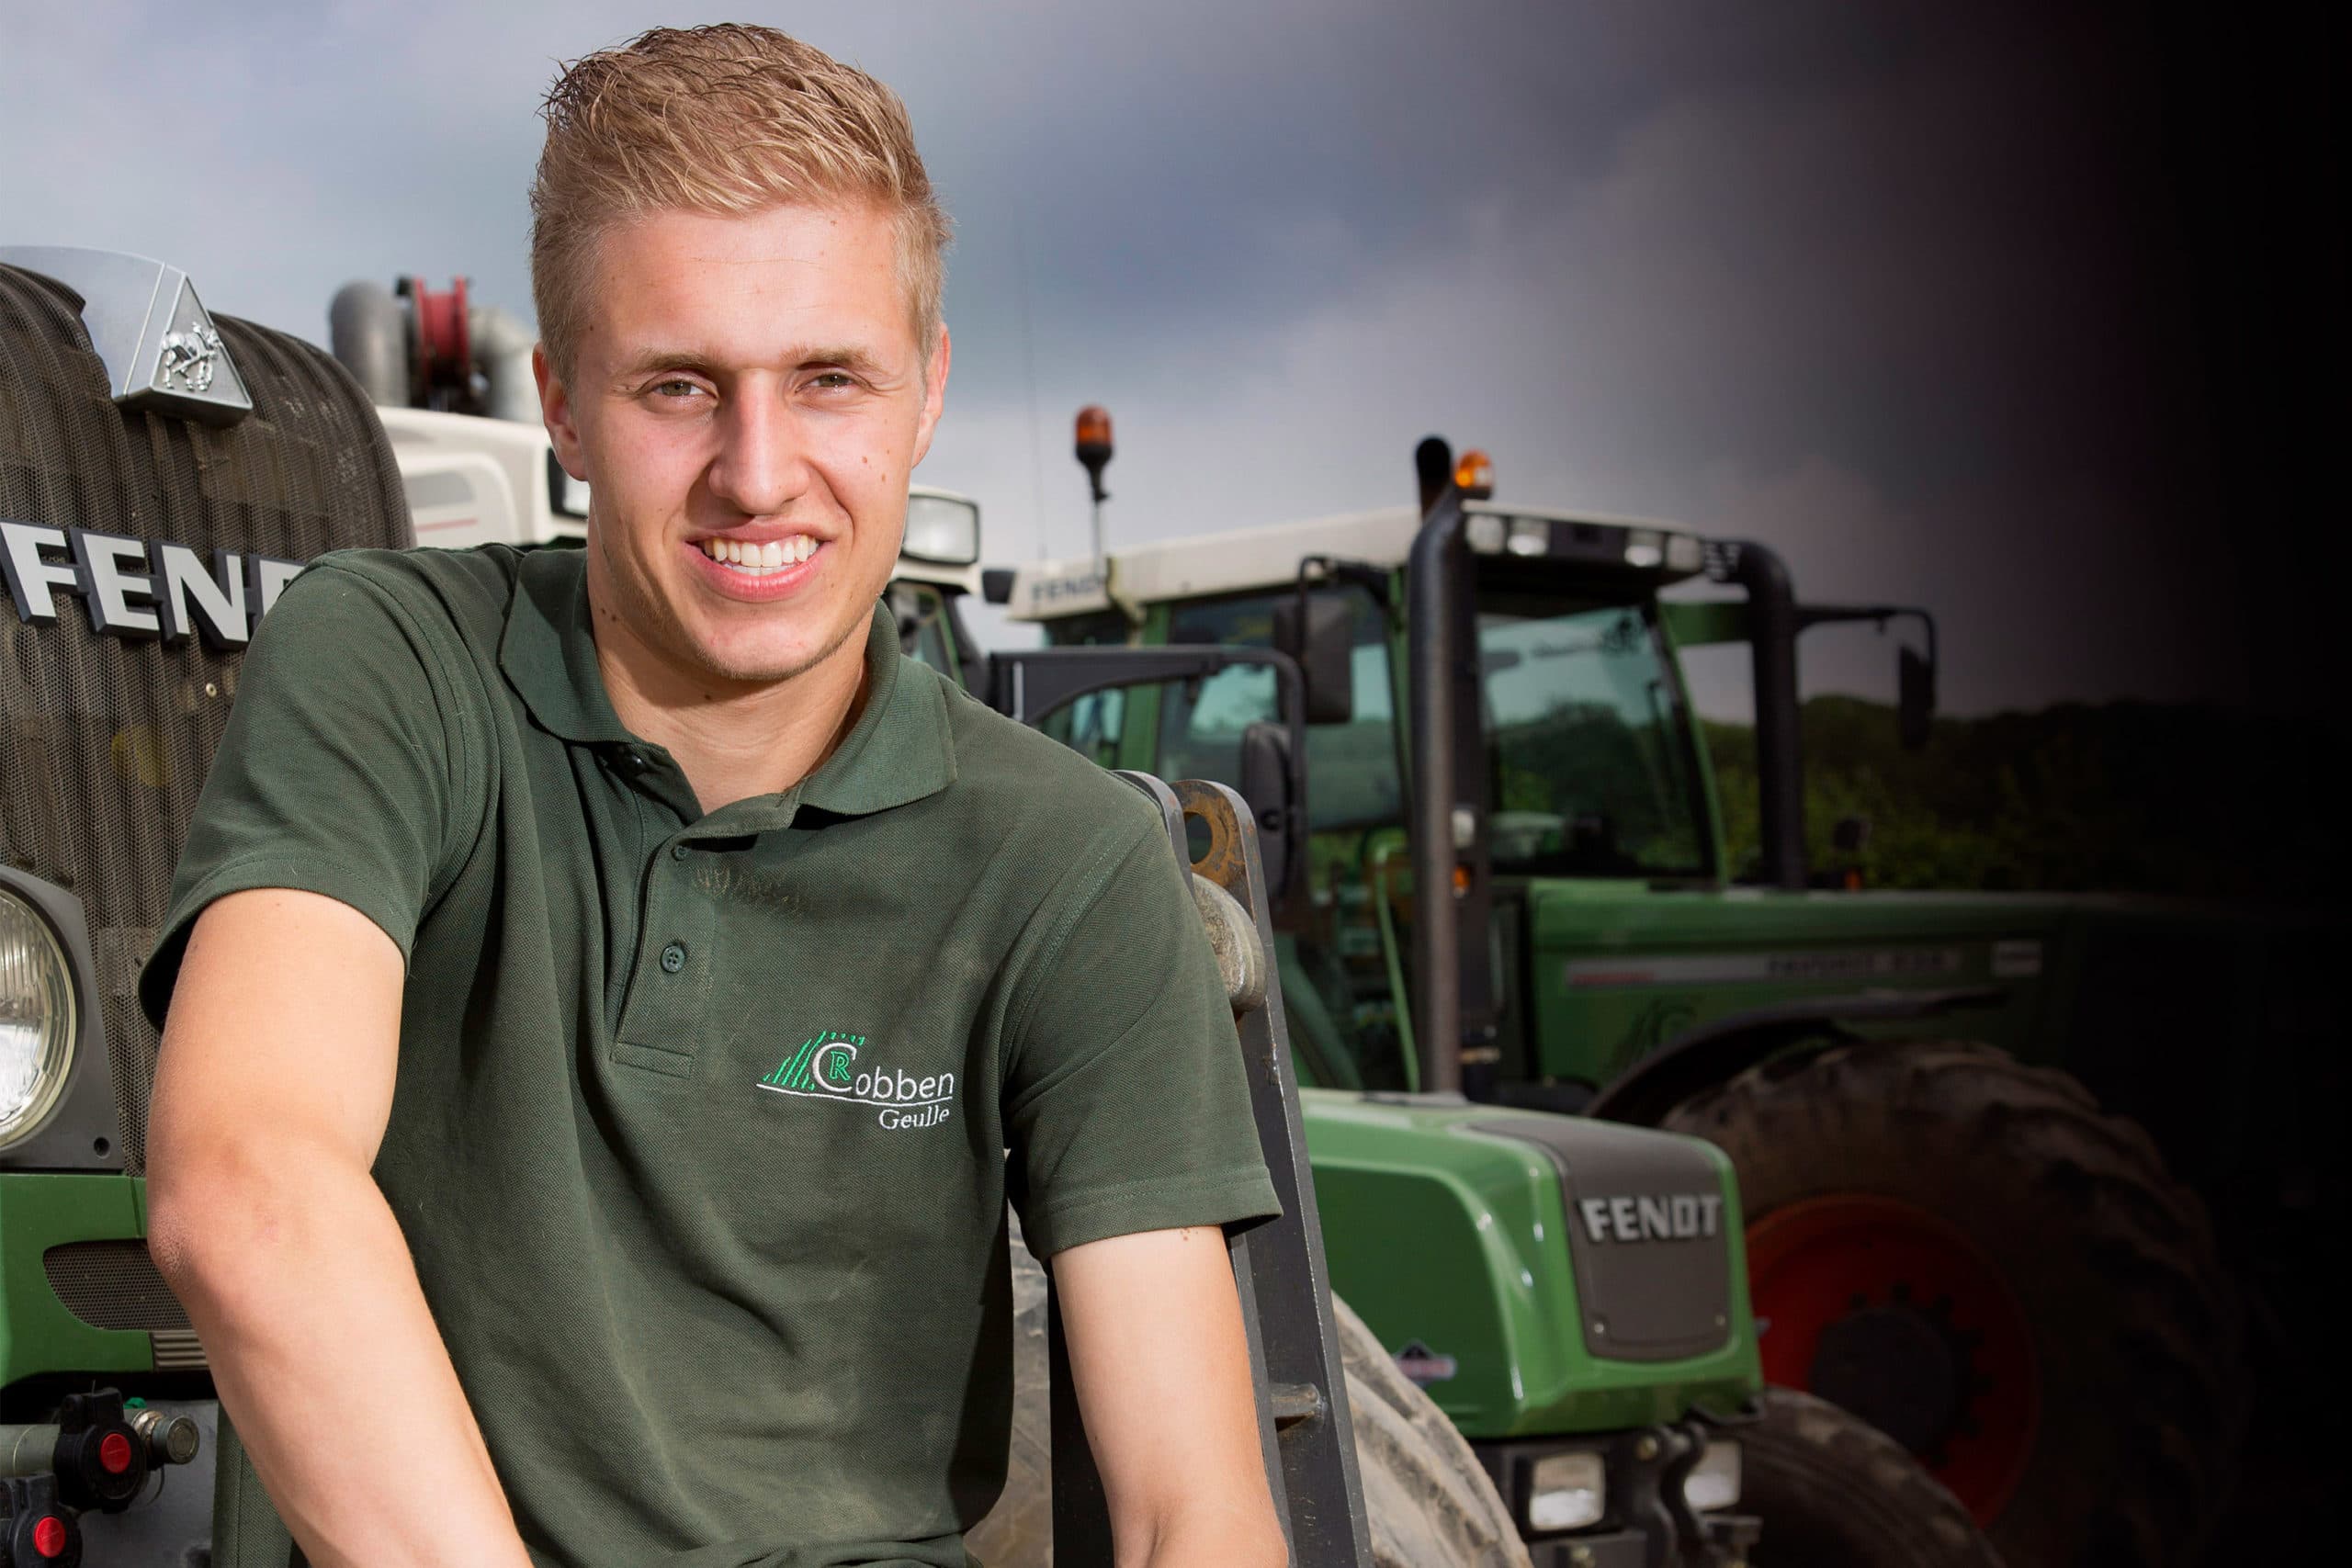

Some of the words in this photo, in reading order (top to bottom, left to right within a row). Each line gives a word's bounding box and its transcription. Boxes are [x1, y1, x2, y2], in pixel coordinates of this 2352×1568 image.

[812, 1042, 955, 1100] Cobben
[878, 1105, 950, 1130] Geulle
[1579, 1196, 1721, 1242] FENDT
